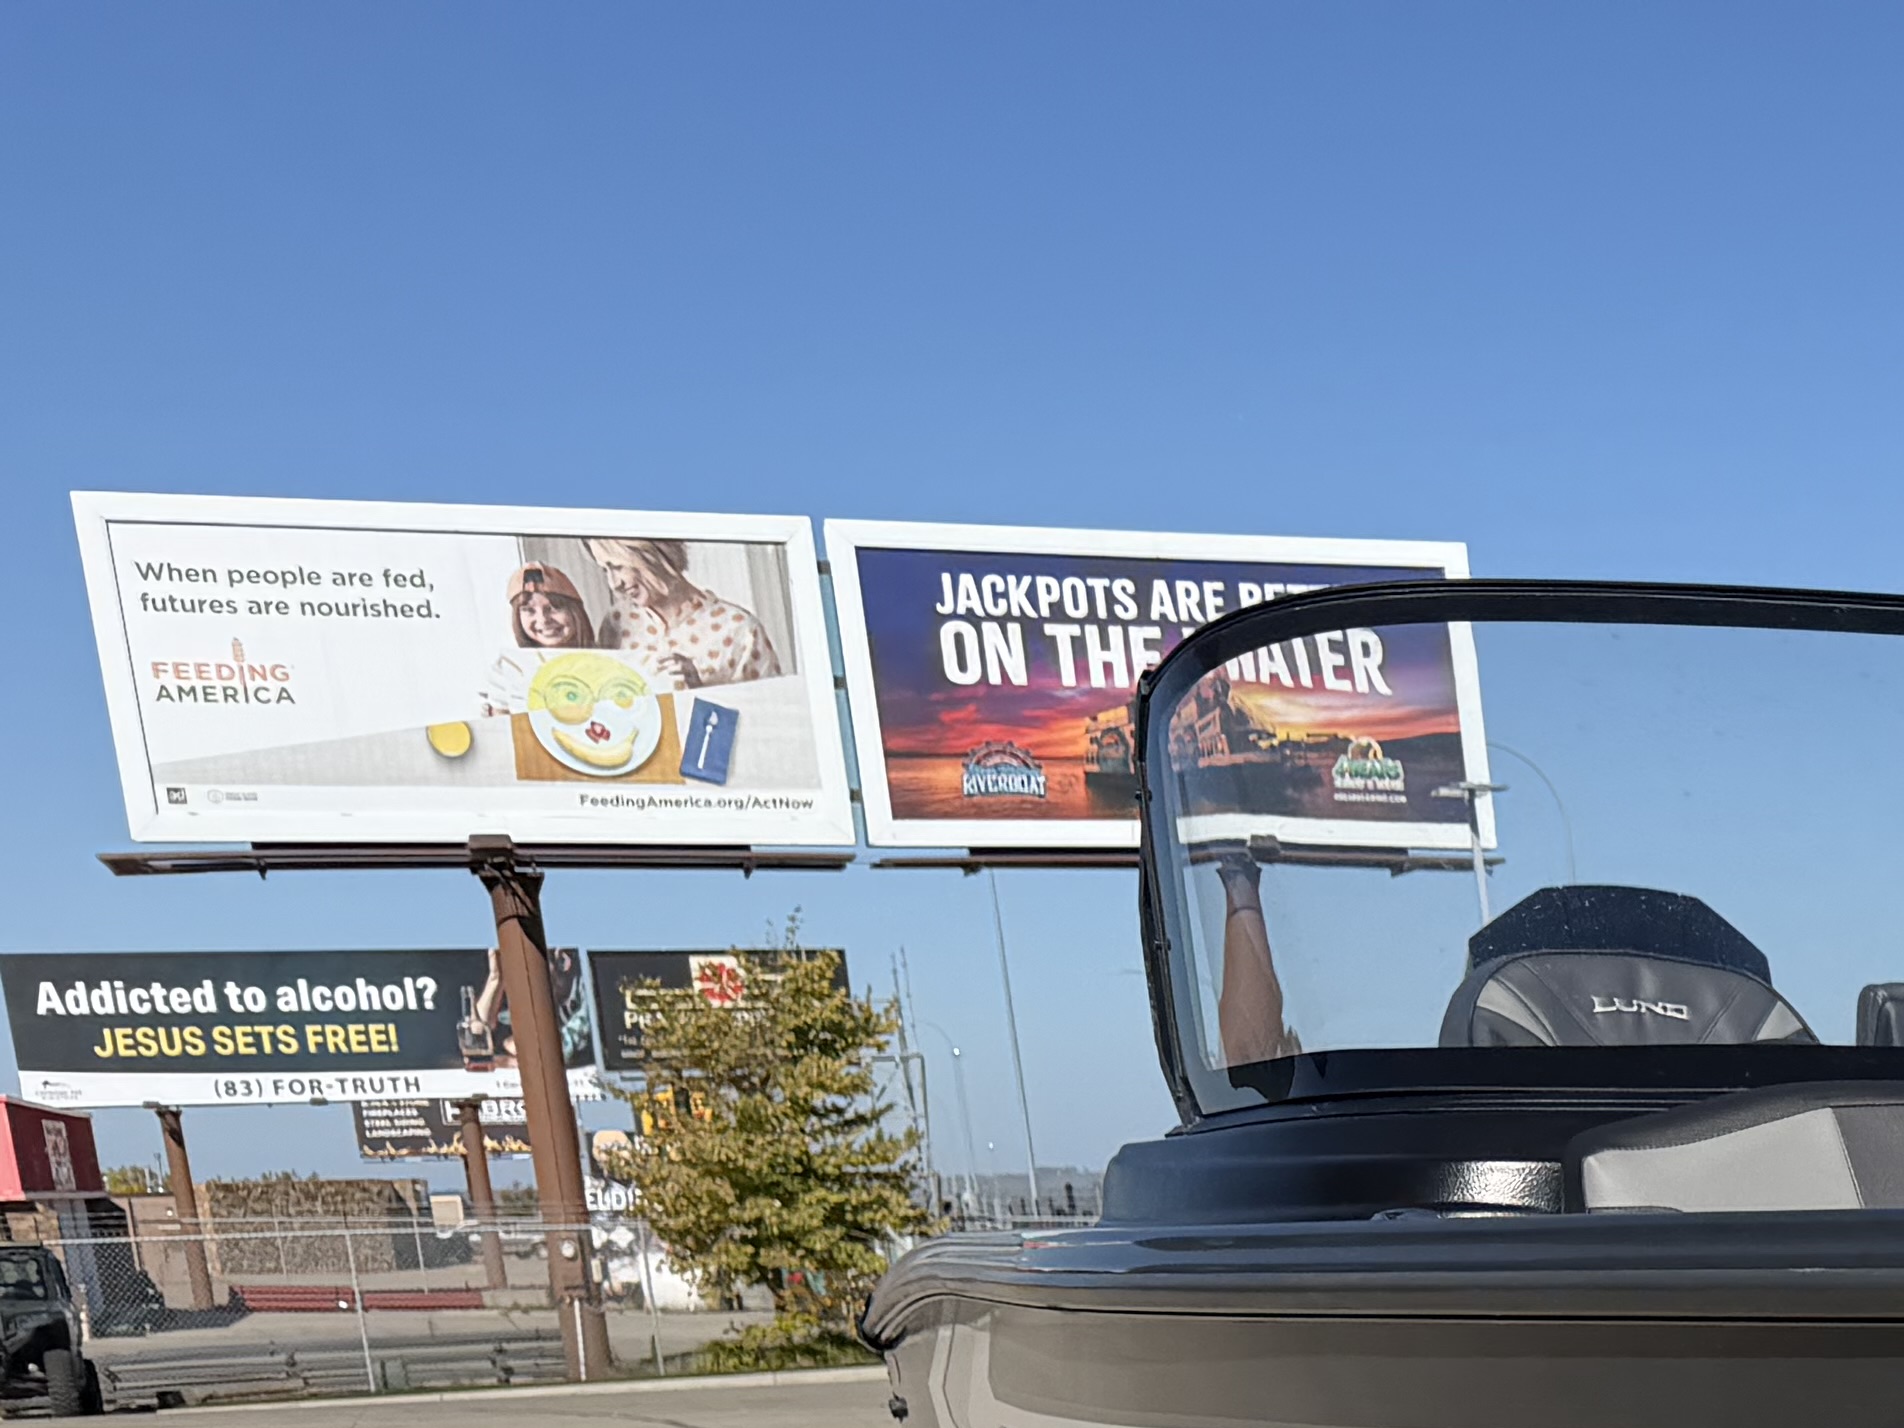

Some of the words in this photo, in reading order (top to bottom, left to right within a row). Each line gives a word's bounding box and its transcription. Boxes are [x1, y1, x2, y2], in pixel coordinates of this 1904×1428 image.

[134, 561, 217, 584] When
[227, 565, 322, 589] people
[332, 570, 373, 588] are
[382, 568, 435, 592] fed,
[140, 592, 238, 614] futures
[248, 599, 290, 615] are
[300, 598, 441, 619] nourished.
[936, 572, 1139, 620] JACKPOTS
[1150, 578, 1226, 623] ARE
[939, 620, 1028, 686] ON
[1044, 623, 1162, 689] THE
[151, 661, 290, 684] FEEDING
[155, 685, 296, 705] AMERICA
[579, 794, 814, 811] FeedingAmerica.org/ActNow
[36, 979, 217, 1016] Addicted
[224, 985, 266, 1013] to
[276, 976, 438, 1014] alcohol?
[1590, 994, 1690, 1021] LUND
[94, 1026, 206, 1058] JESUS
[212, 1024, 299, 1056] SETS
[304, 1023, 400, 1055] FREE!
[214, 1078, 264, 1098] (83)
[273, 1076, 421, 1096] FOR-TRUTH
